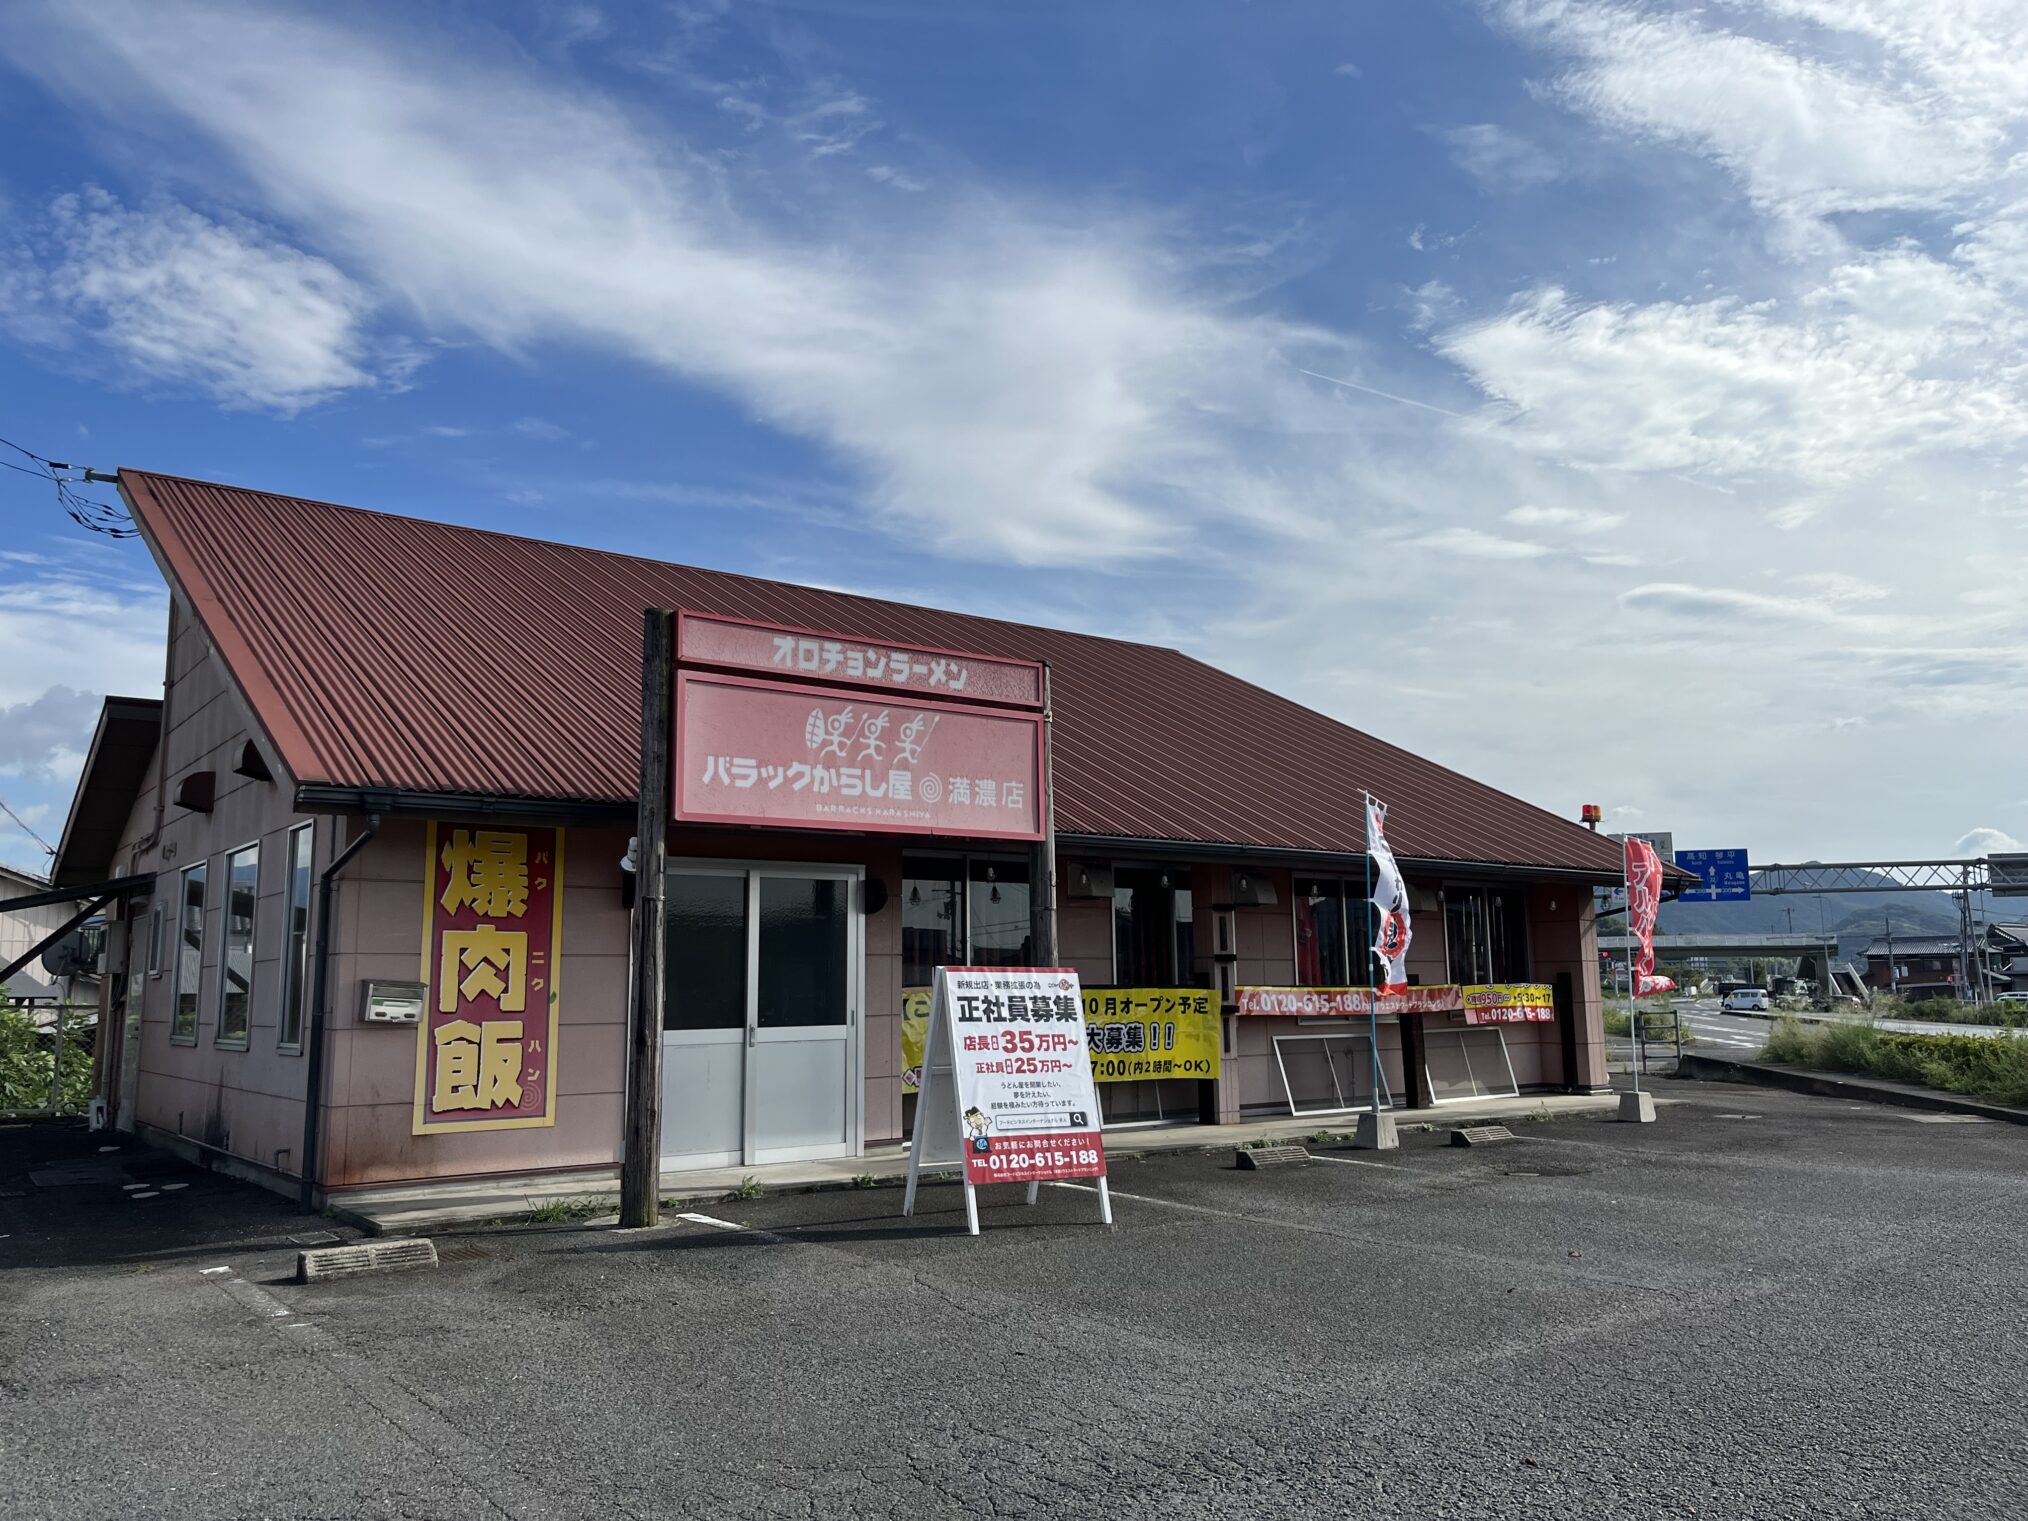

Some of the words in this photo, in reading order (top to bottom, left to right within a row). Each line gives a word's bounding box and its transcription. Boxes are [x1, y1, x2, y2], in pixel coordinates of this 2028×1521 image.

[772, 636, 968, 690] オロチョンラーメン
[702, 755, 912, 800] バラックからし屋
[948, 775, 1024, 809] 満濃店
[816, 804, 873, 815] BARRACKS
[875, 808, 932, 819] KARASHIYA
[432, 829, 529, 1113] 爆肉飯
[957, 980, 1041, 990] 新規出店・業務拡張の為
[957, 995, 1078, 1023] 正社員募集
[1260, 993, 1361, 1012] 0120-615-188
[971, 1158, 988, 1168] TEL
[989, 1150, 1099, 1169] 0120-615-188
